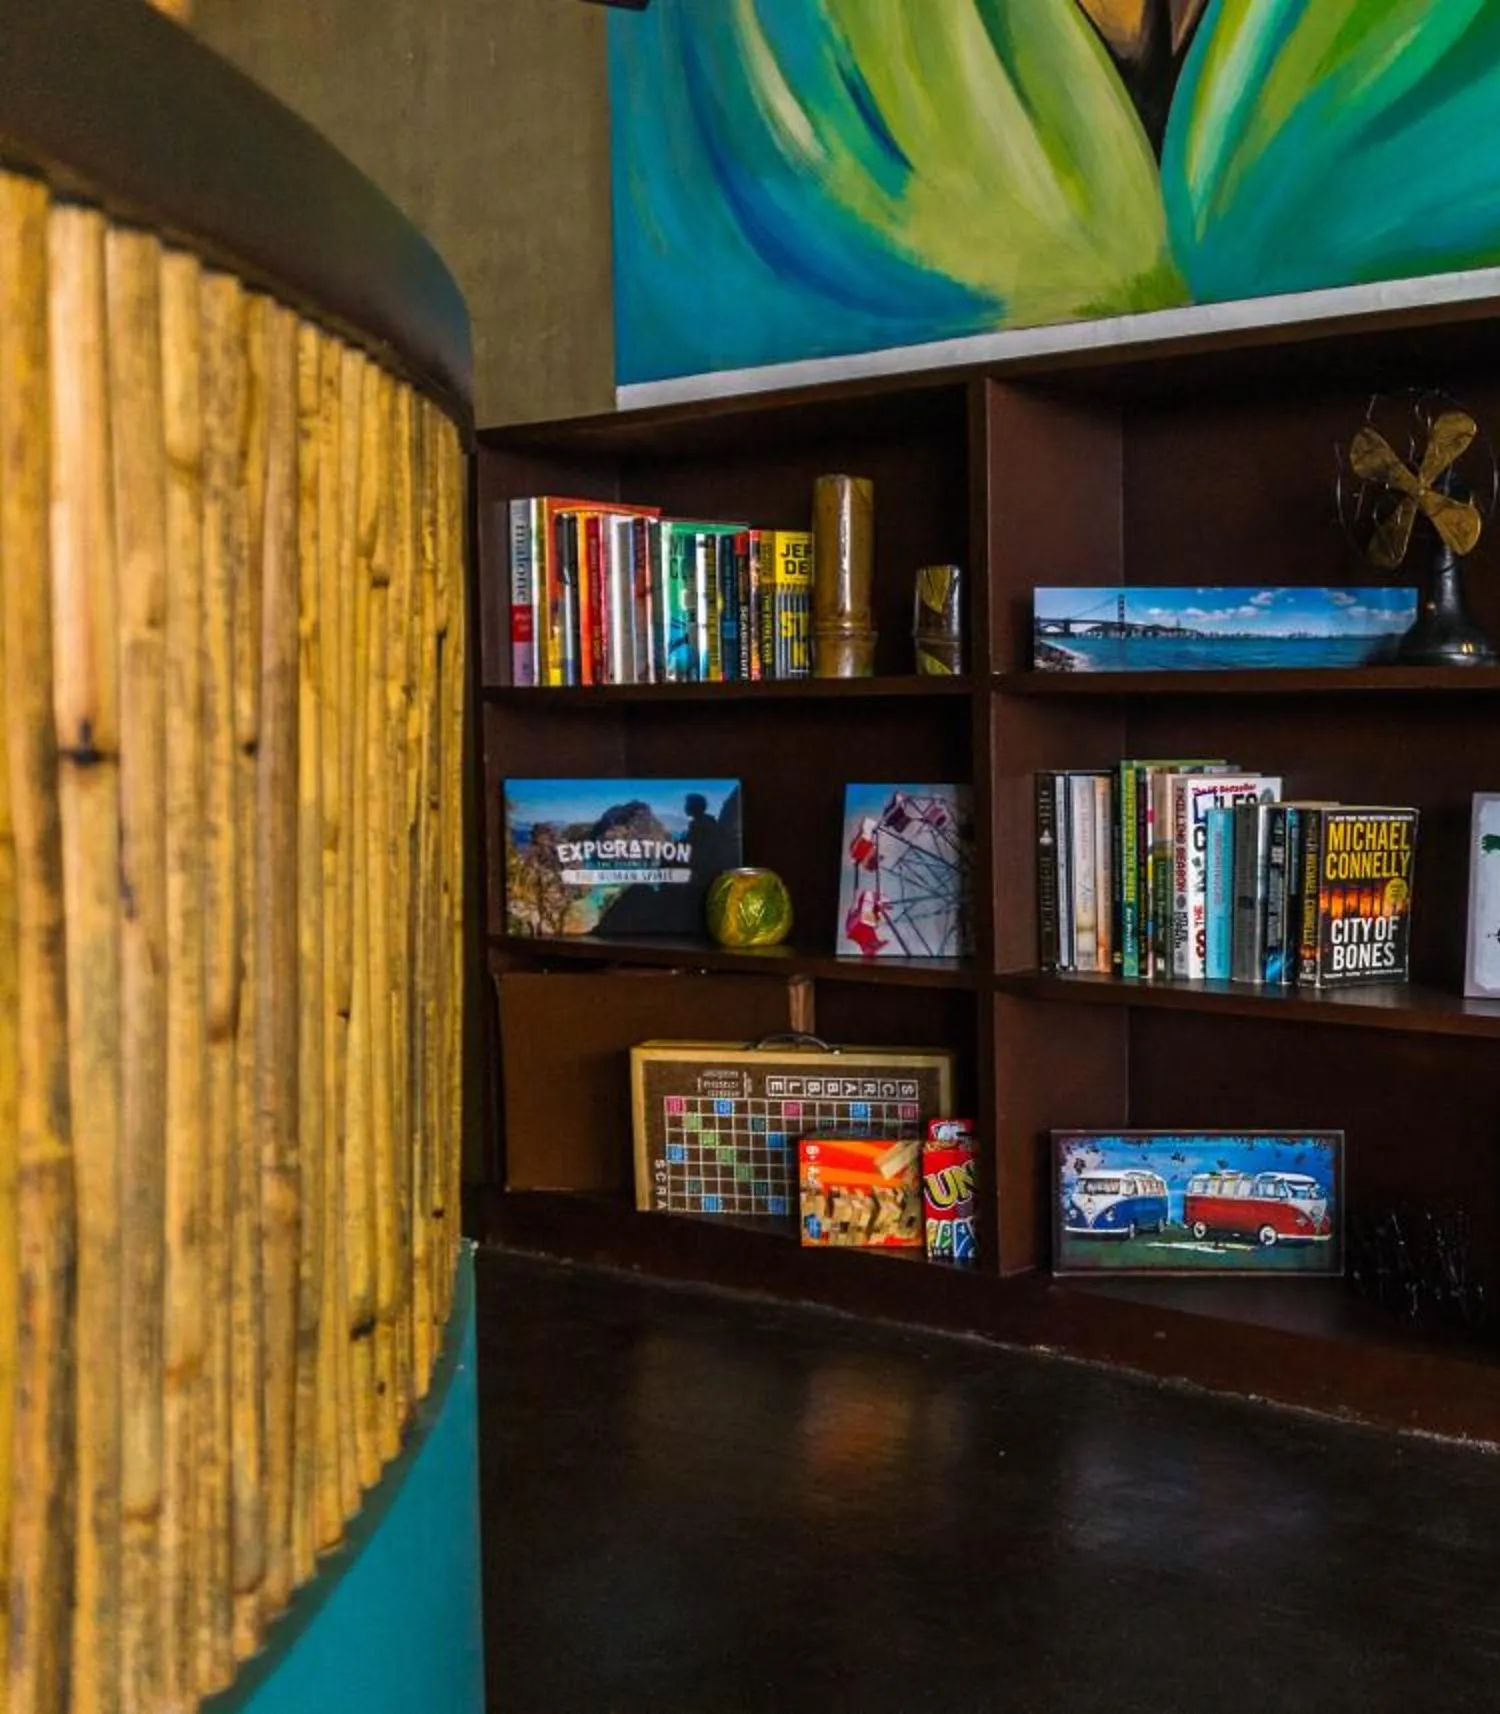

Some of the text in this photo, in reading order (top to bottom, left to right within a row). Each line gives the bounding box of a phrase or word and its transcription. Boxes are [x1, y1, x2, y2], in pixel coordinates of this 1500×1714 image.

[557, 839, 692, 863] EXPLORATION
[1328, 821, 1411, 852] MICHAEL
[1325, 850, 1412, 880] CONNELLY
[1331, 915, 1400, 944] CITY OF
[1332, 941, 1396, 971] BONES
